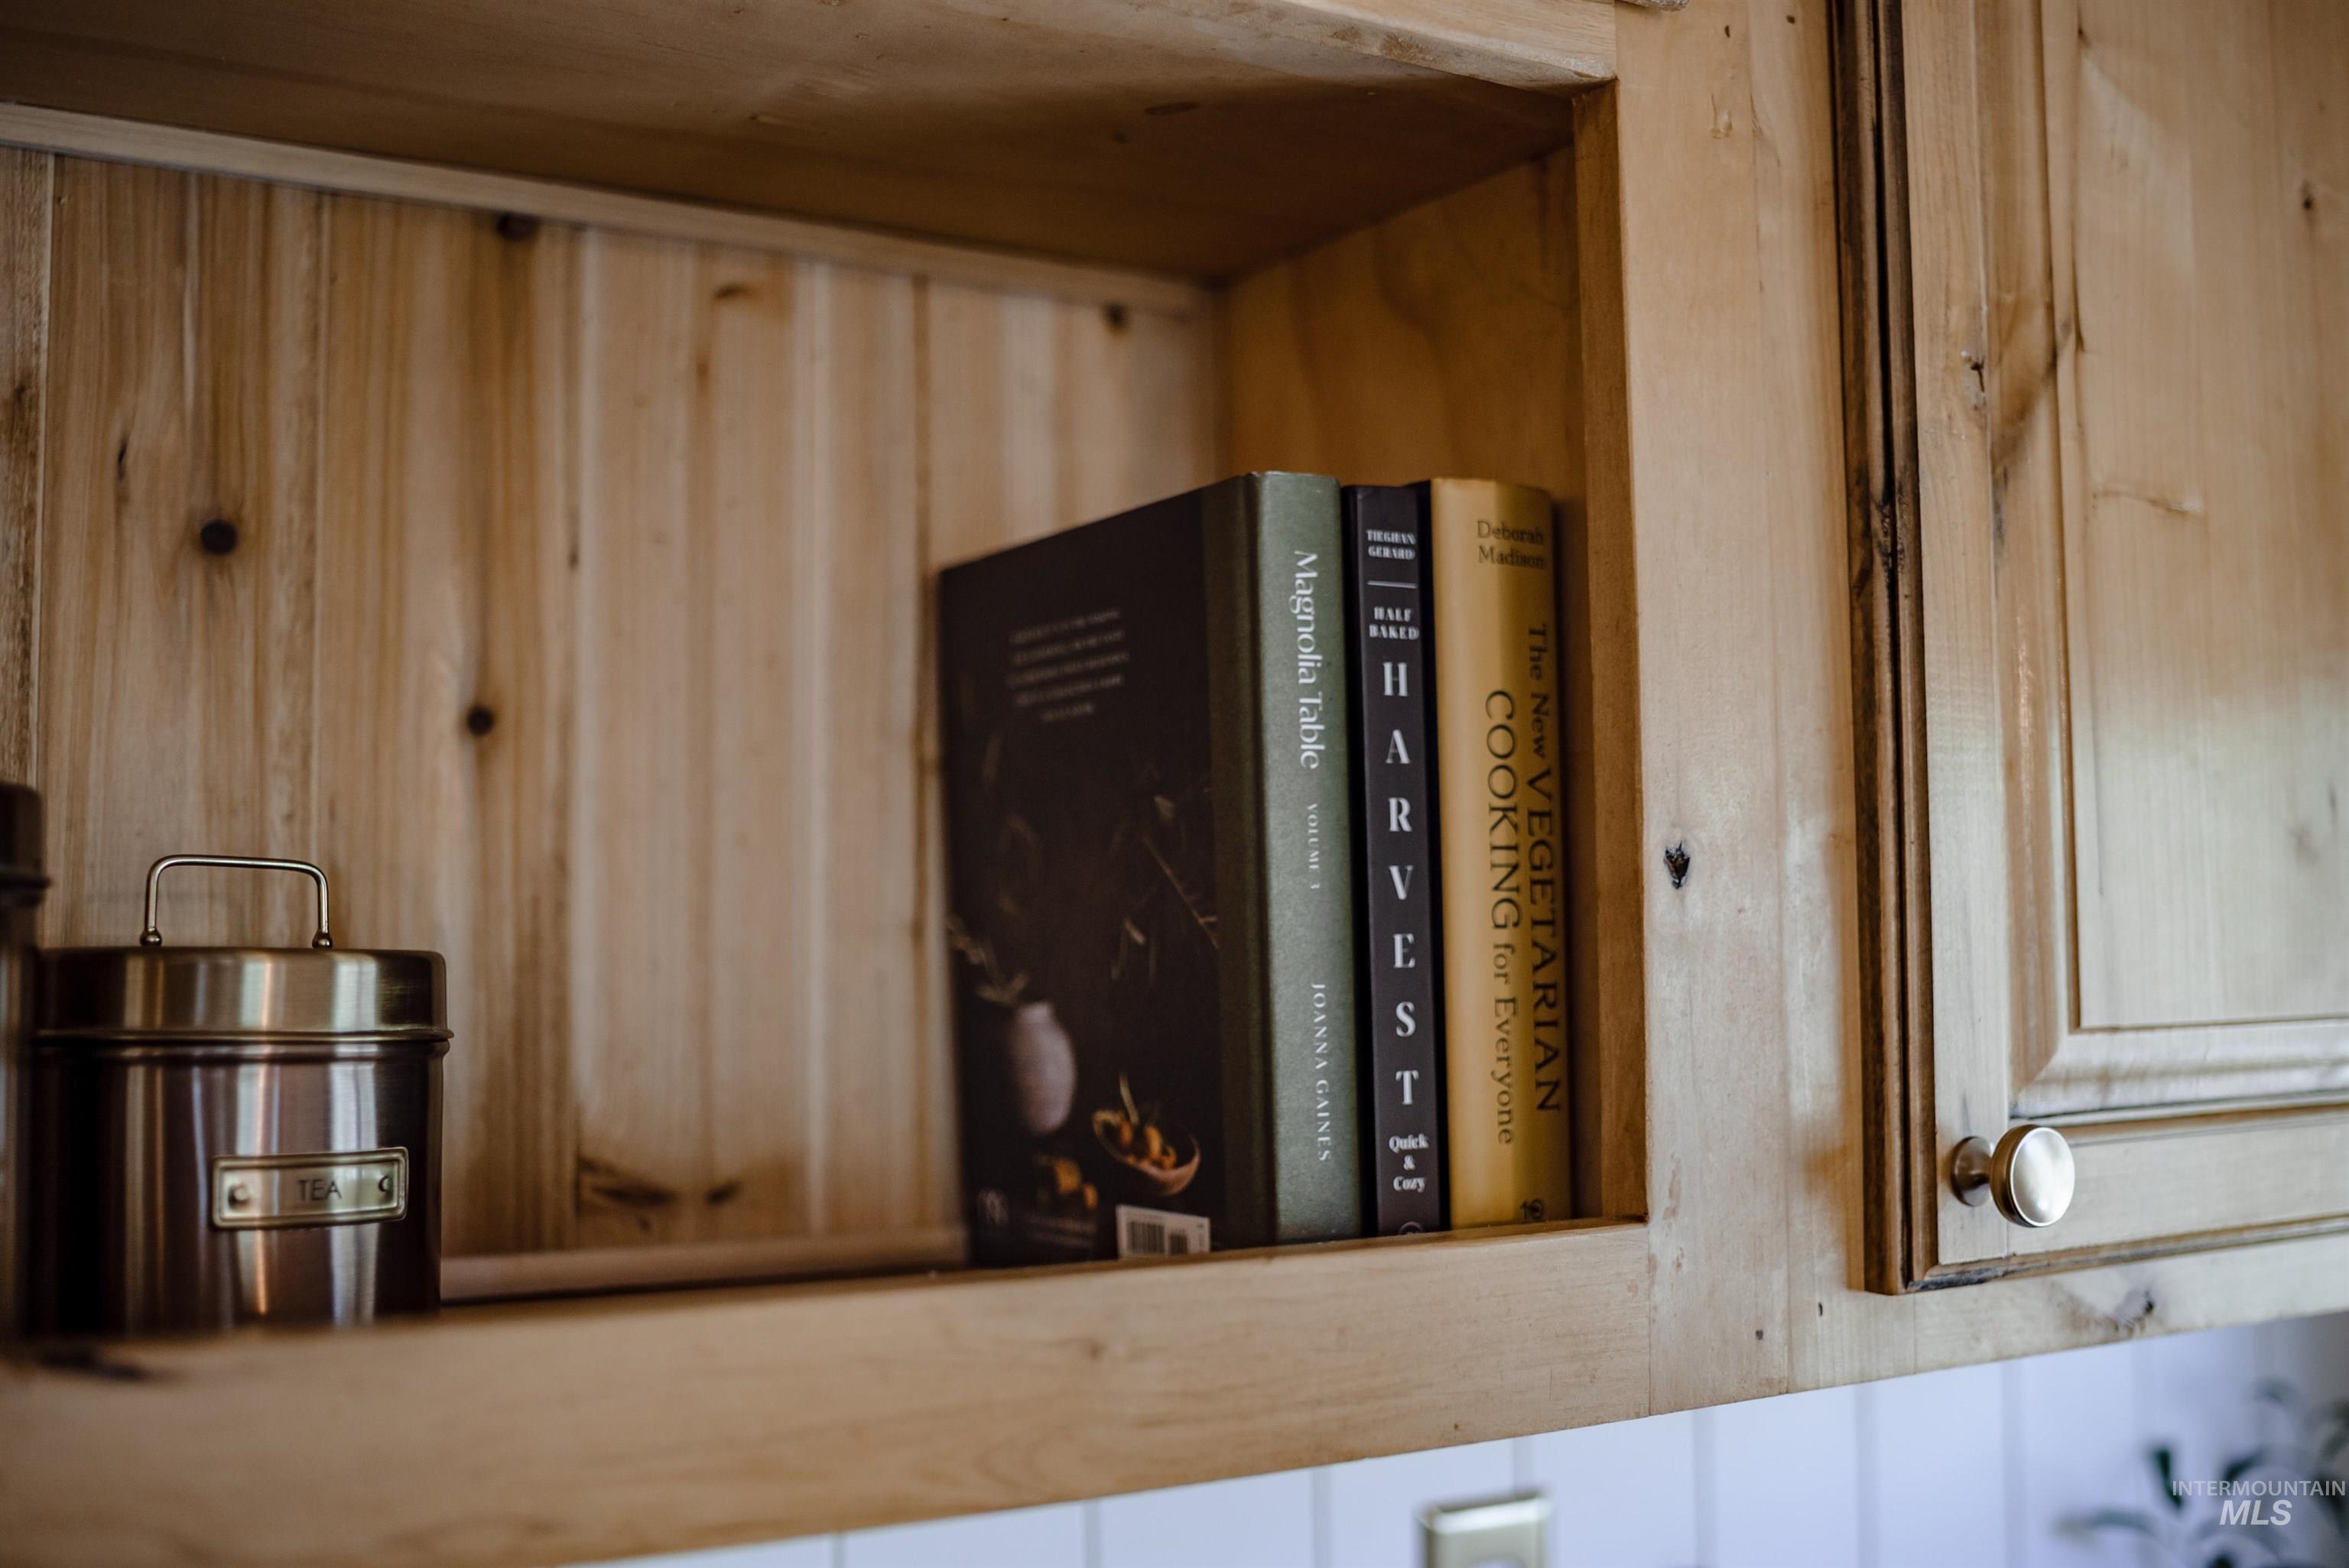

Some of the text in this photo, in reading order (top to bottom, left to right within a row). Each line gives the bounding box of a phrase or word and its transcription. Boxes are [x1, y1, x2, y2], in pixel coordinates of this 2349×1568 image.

[1477, 521, 1544, 544] Deborah
[1477, 545, 1545, 569] Madison
[1373, 607, 1412, 622] HALF
[1369, 625, 1419, 640] BAKED
[1288, 550, 1326, 770] Magnolia Table
[1526, 624, 1561, 1112] The New VEGETARIAN
[1485, 690, 1522, 1144] COOKING for Everyone
[1311, 983, 1331, 1161] JOANNA GAINES
[1389, 1133, 1429, 1153] Quick
[297, 1178, 342, 1201] TEA
[1393, 1175, 1425, 1193] Cozy
